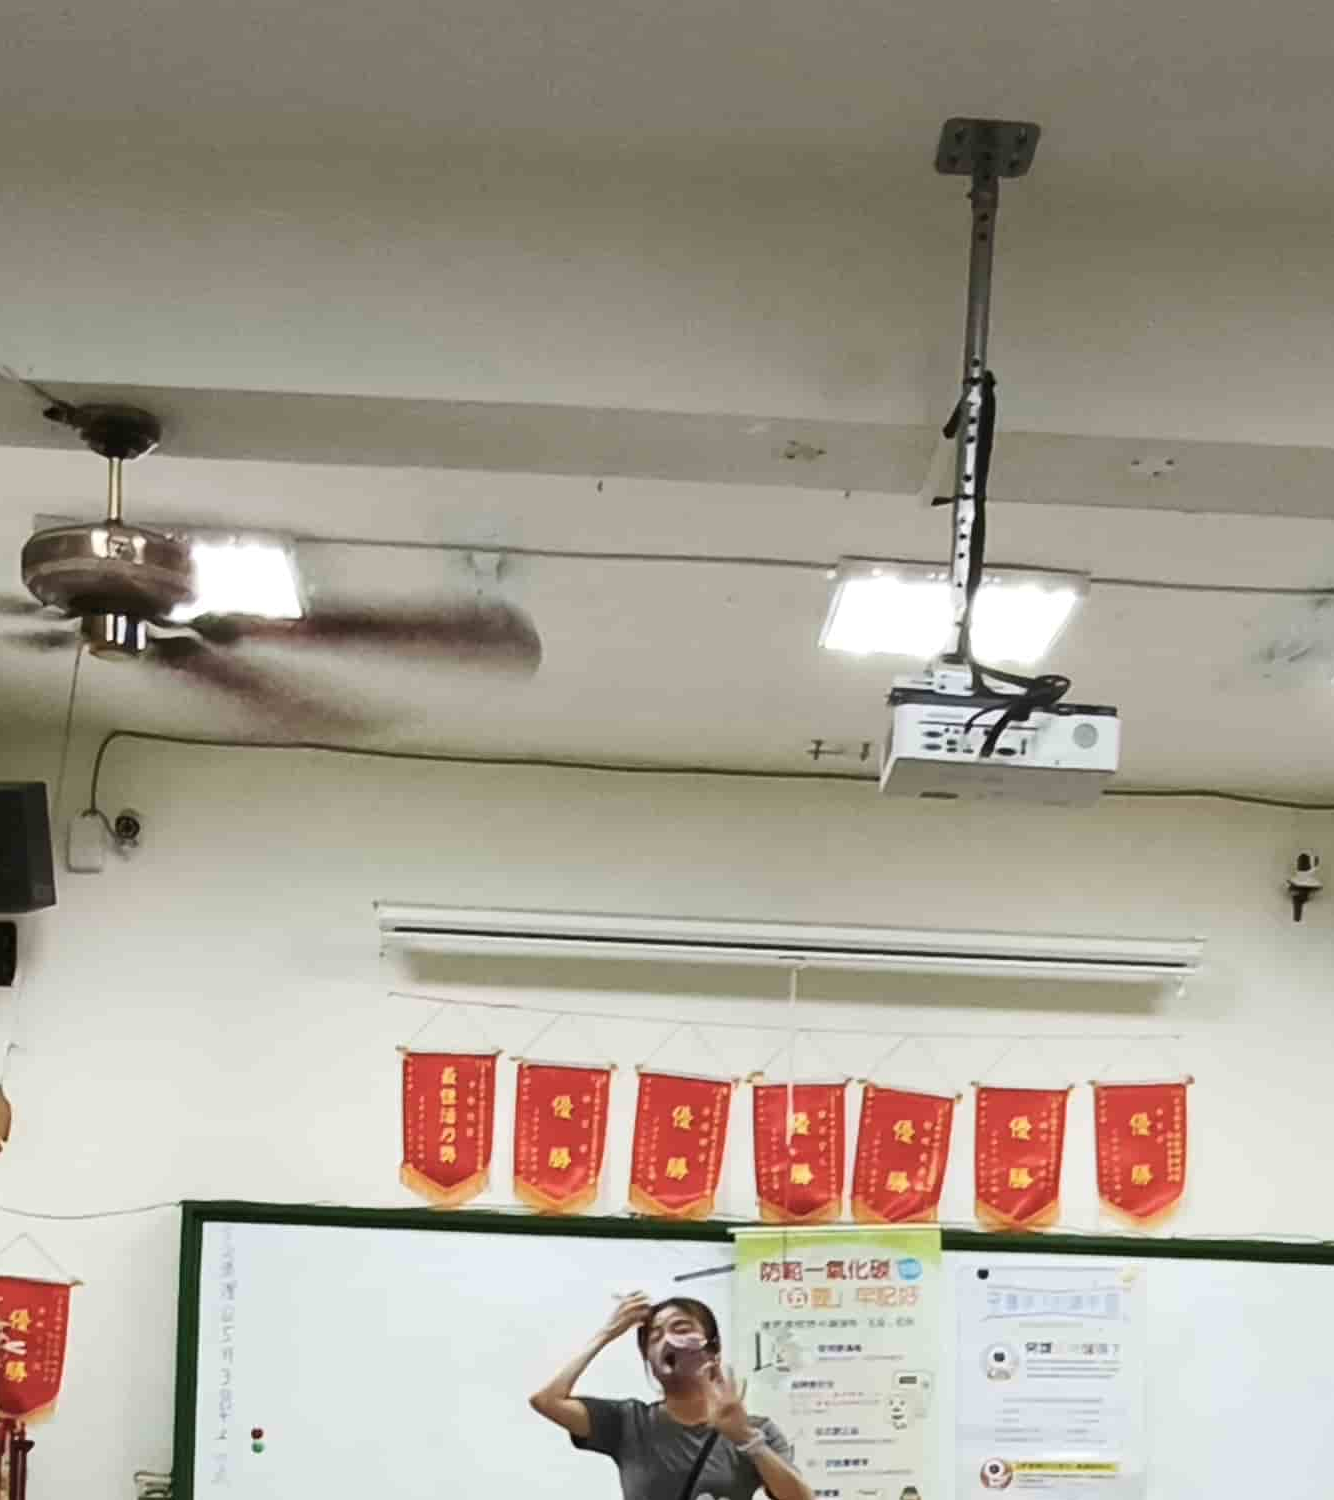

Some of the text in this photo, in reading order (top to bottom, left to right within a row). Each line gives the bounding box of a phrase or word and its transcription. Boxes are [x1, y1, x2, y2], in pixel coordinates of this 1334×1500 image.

[760, 1258, 890, 1283] 防範一氧化碳
